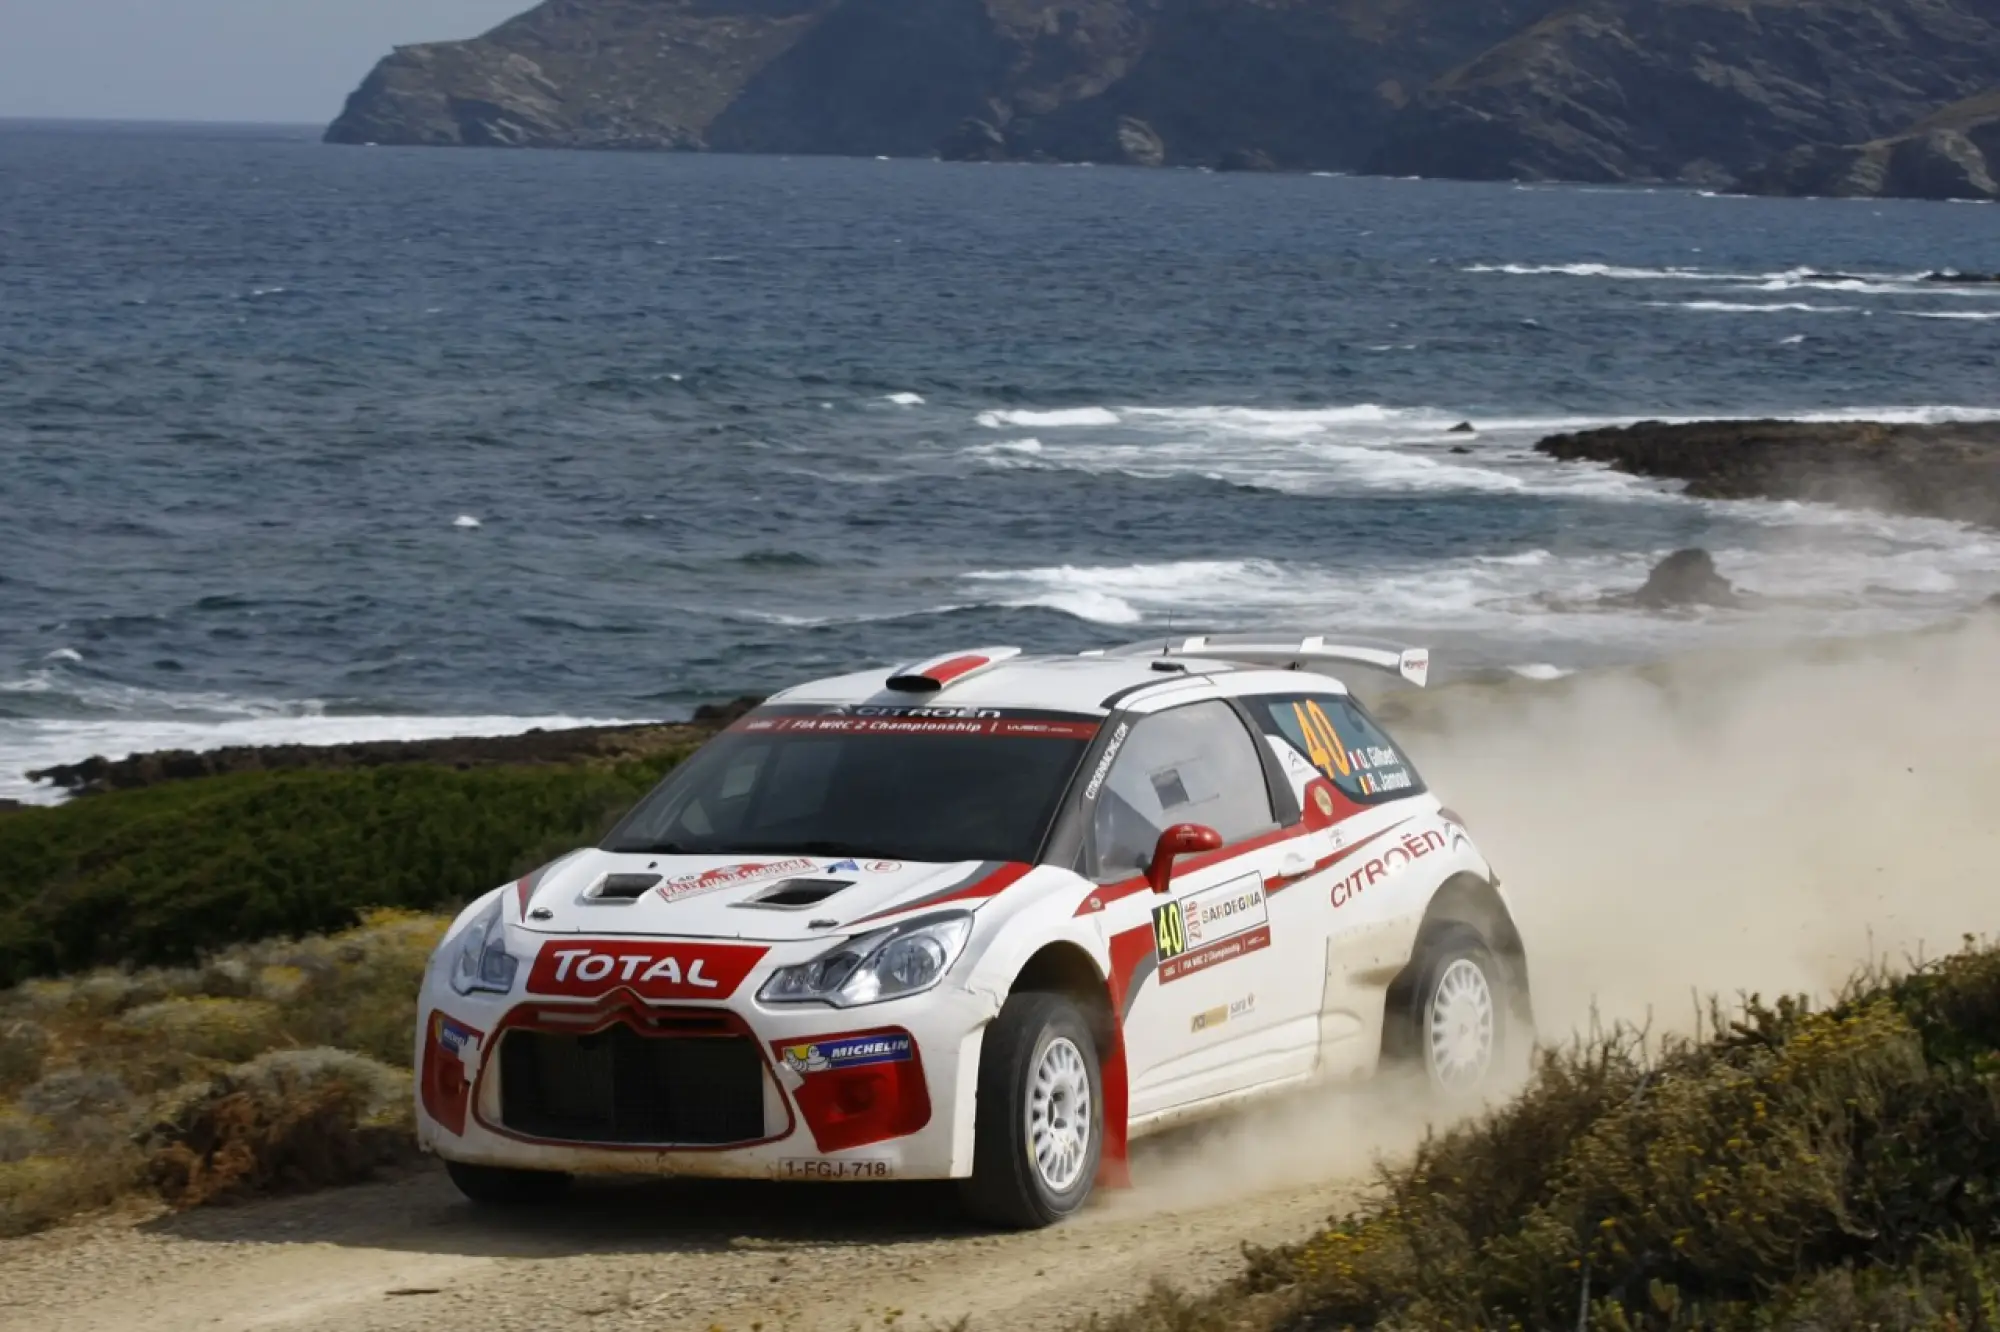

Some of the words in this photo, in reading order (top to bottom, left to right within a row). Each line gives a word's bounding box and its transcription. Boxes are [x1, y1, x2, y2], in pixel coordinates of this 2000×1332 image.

[791, 719, 817, 730] FIA
[819, 719, 853, 730] WRC
[869, 720, 981, 733] Championship
[1292, 699, 1350, 780] 40
[1201, 891, 1262, 924] SARDEGNA
[1159, 903, 1182, 957] 40
[554, 949, 721, 988] TOTAL
[831, 1041, 909, 1059] MICHELIN
